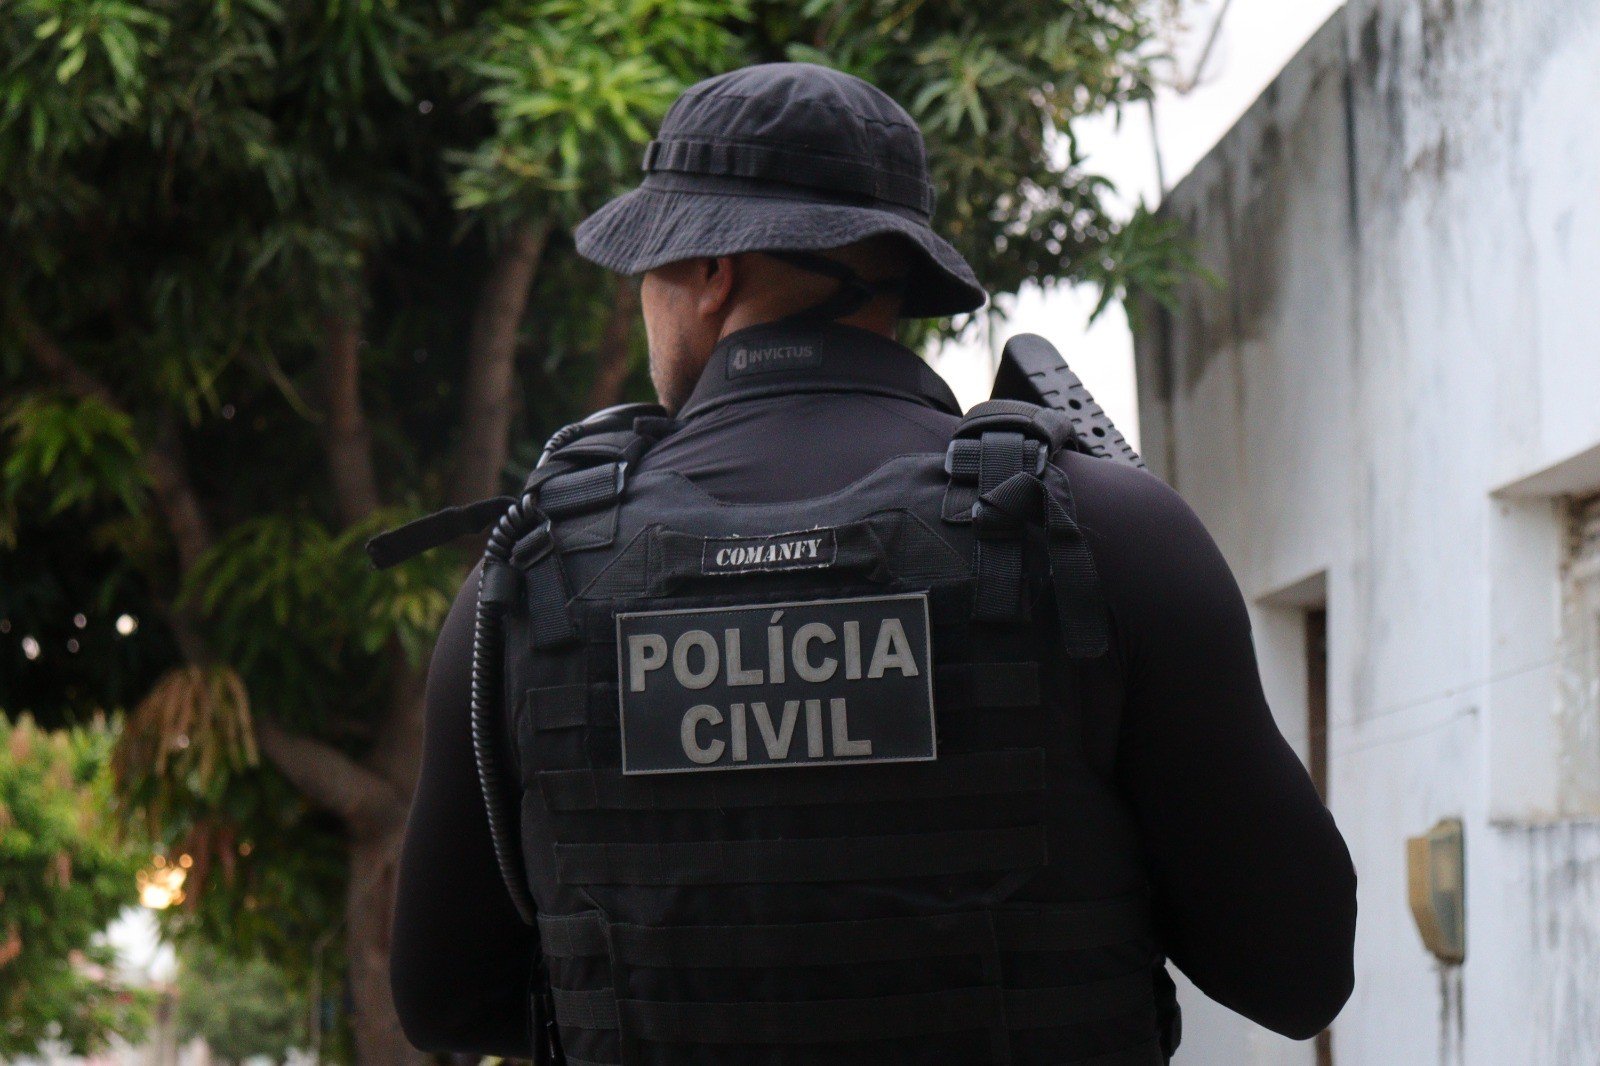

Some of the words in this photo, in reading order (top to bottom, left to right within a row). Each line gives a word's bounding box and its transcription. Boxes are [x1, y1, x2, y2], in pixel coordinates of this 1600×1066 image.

[749, 345, 814, 363] INVICTUS
[716, 538, 822, 566] COMANFY
[628, 610, 919, 692] POLÍCIA
[680, 698, 872, 764] CIVIL
